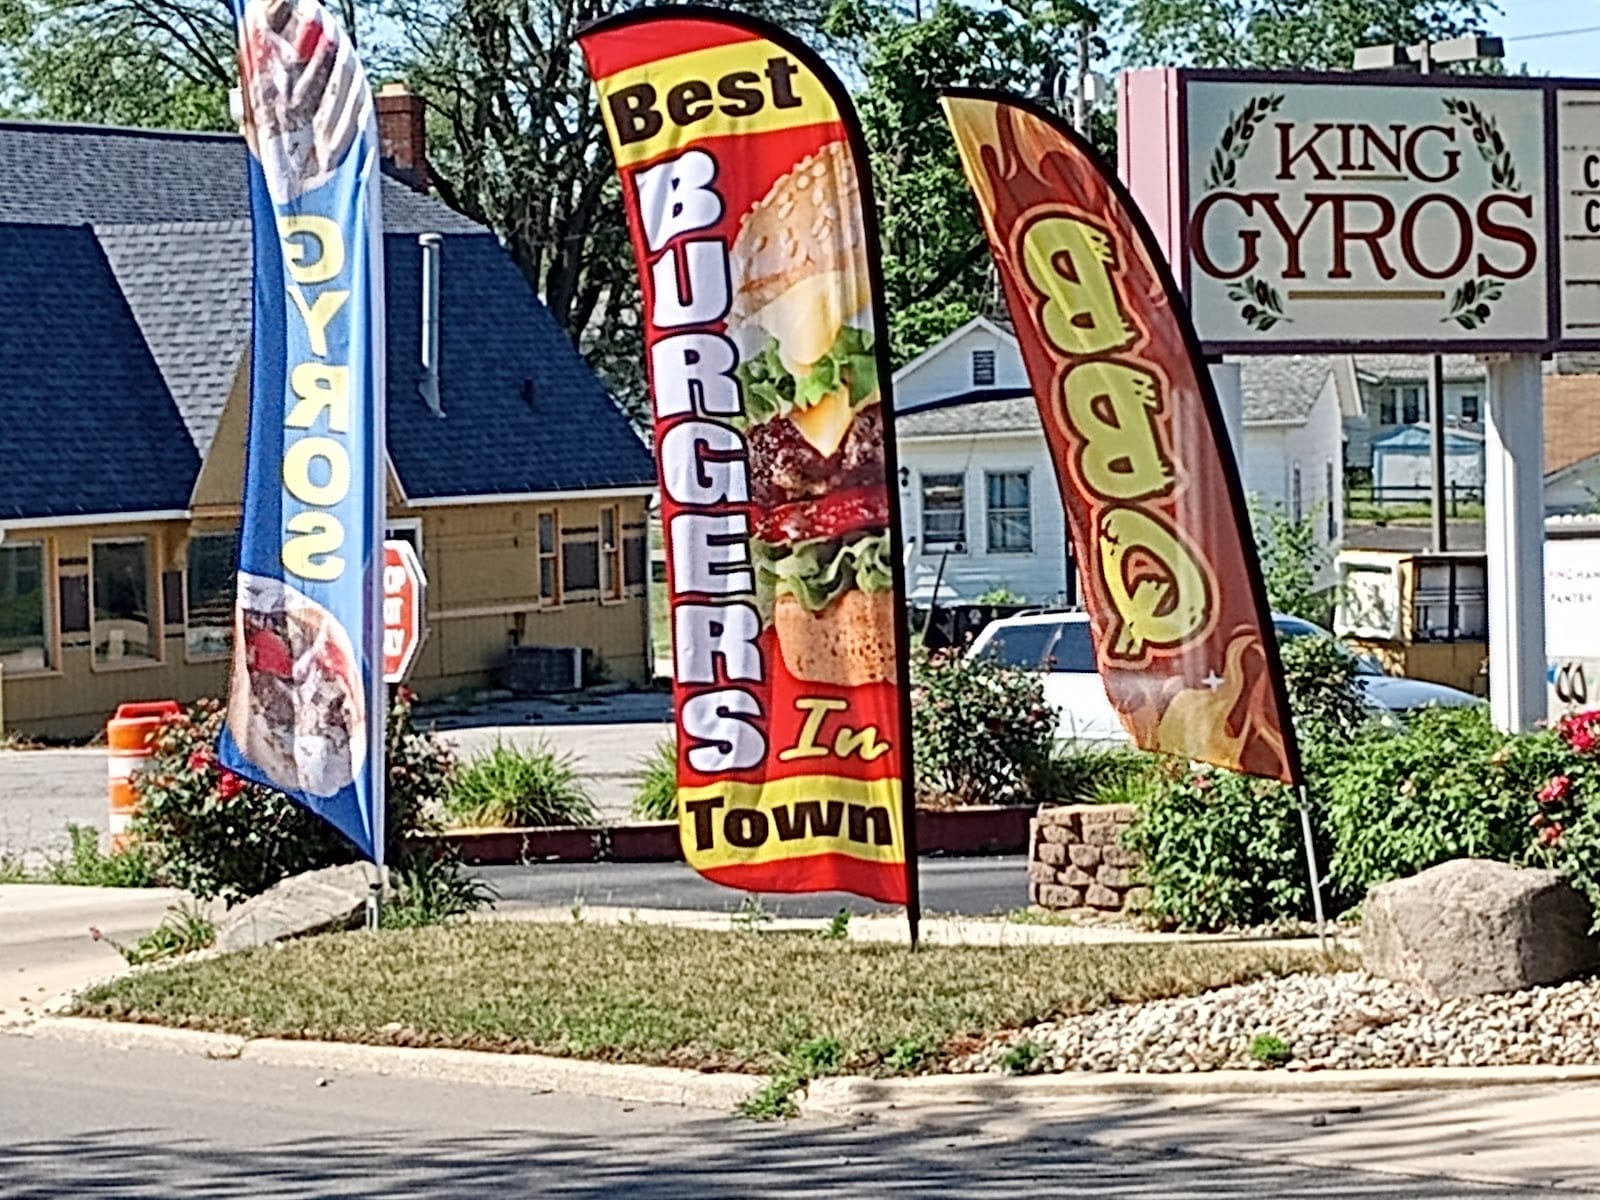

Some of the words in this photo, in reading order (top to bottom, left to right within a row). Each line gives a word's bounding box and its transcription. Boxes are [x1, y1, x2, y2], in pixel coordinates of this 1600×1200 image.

[607, 56, 803, 146] Best
[1275, 123, 1461, 183] KING
[1191, 192, 1537, 280] GYROS
[633, 149, 768, 773] BURGERS
[779, 698, 890, 761] In
[685, 796, 893, 851] Town
